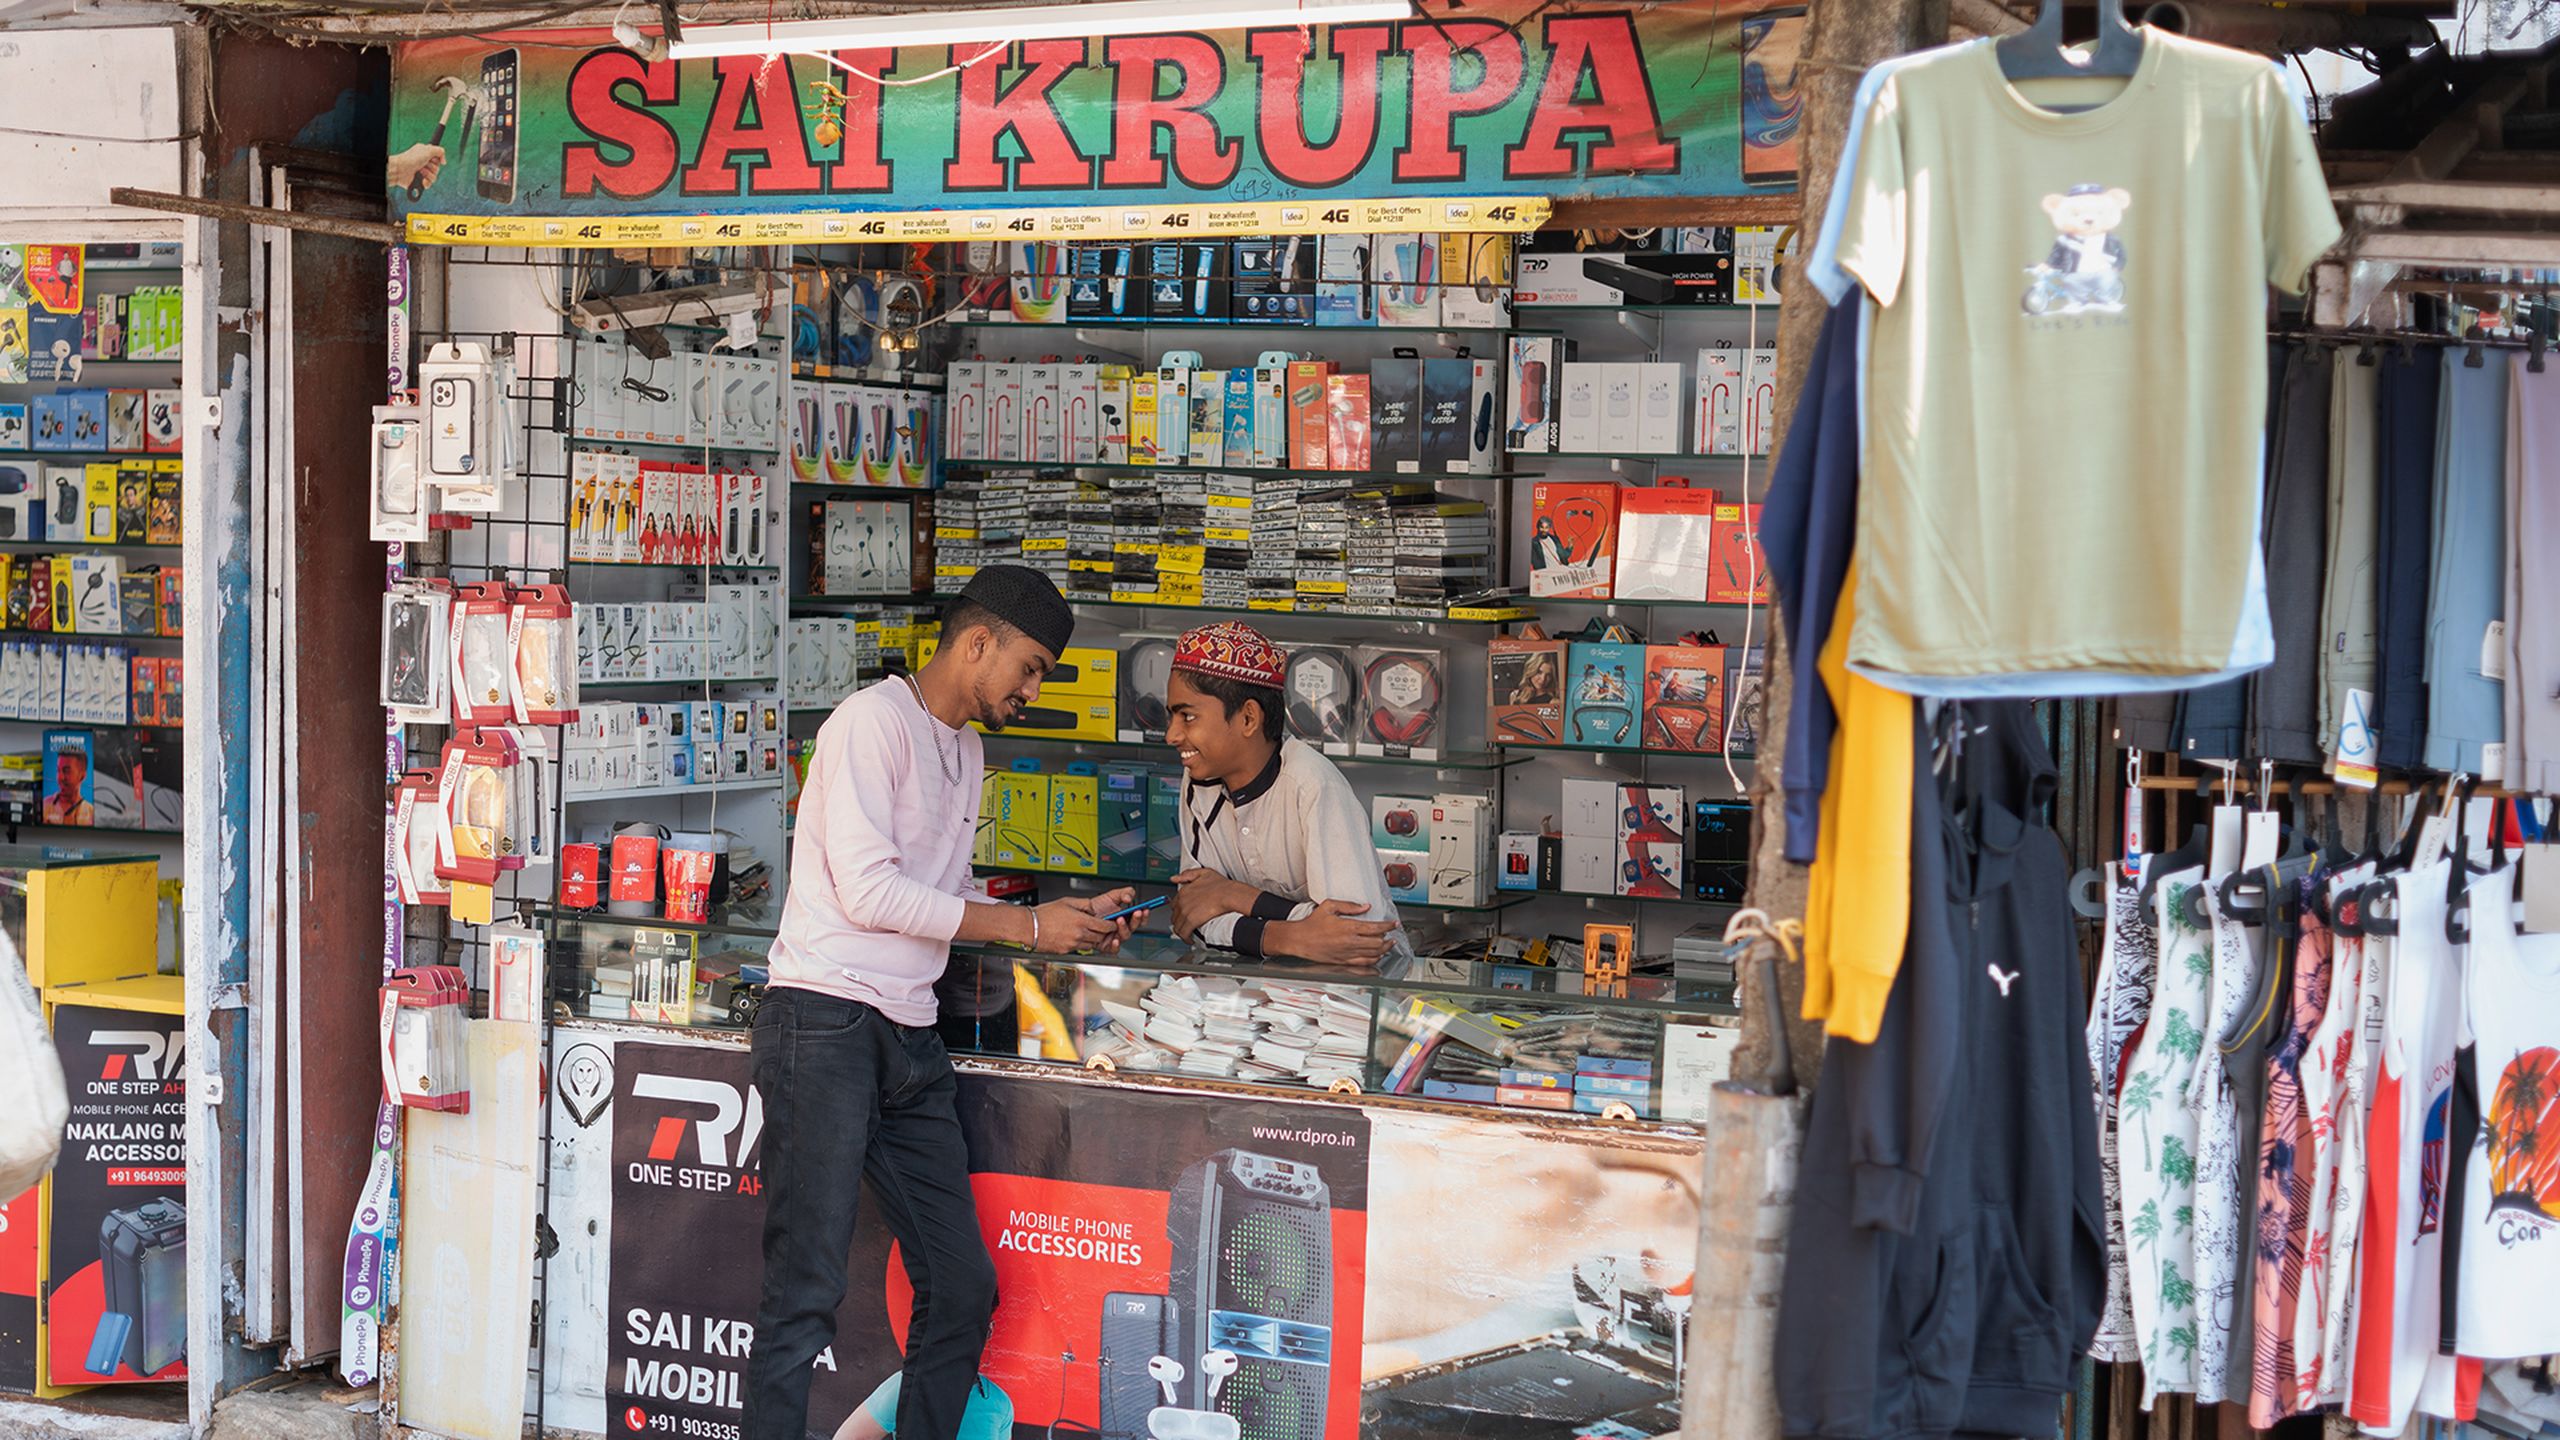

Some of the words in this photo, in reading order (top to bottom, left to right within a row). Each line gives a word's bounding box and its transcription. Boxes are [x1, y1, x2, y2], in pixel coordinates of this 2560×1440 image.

[561, 46, 897, 200] SAI
[943, 9, 1681, 193] KRUPA
[1081, 215, 1101, 223] Offers
[1161, 213, 1189, 227] 4G
[1321, 208, 1349, 223] 4G
[1367, 207, 1379, 215] For
[1398, 206, 1421, 214] Offers
[1487, 206, 1517, 222] 4G
[445, 223, 467, 236] 4G
[578, 225, 601, 238] 4G
[716, 223, 741, 237] 4G
[859, 221, 885, 235] 4G
[1008, 217, 1034, 232] 4G
[391, 313, 400, 362] PhonePe
[1385, 401, 1405, 410] DARE
[1436, 401, 1456, 410] DARE
[1379, 416, 1406, 425] LISTEN
[1431, 416, 1457, 425] LISTEN
[1552, 568, 1598, 588] THUNDER
[453, 608, 466, 643] NOBLE
[509, 609, 523, 648] NOBLE
[444, 754, 461, 790] NOBLE
[398, 793, 413, 829] NOBLE
[1002, 789, 1011, 821] YOGA
[1055, 792, 1065, 824] YOGA
[386, 822, 396, 870] PhonePe
[571, 872, 585, 882] Jio
[626, 863, 642, 872] Jio
[384, 907, 395, 955] PhonePe
[383, 995, 396, 1029] NOBLE
[87, 1083, 120, 1095] ONE
[122, 1082, 160, 1095] STEP
[73, 1104, 112, 1116] MOBILE
[114, 1104, 150, 1115] PHONE
[67, 1124, 164, 1141] NAKLANG
[1252, 1126, 1356, 1148] www.rdpro.in
[110, 1172, 131, 1182] +91
[369, 1157, 390, 1205] PhonePe
[629, 1163, 672, 1186] ONE
[679, 1168, 732, 1192] STEP
[1009, 1209, 1069, 1234] MOBILE
[1074, 1216, 1133, 1240] PHONE
[998, 1228, 1143, 1266] ACCESSORIES
[358, 1239, 373, 1284] PhonePe
[626, 1308, 691, 1351] SAI
[355, 1318, 367, 1367] PhonePe
[624, 1357, 744, 1410] MOBIL
[649, 1414, 676, 1433] +91
